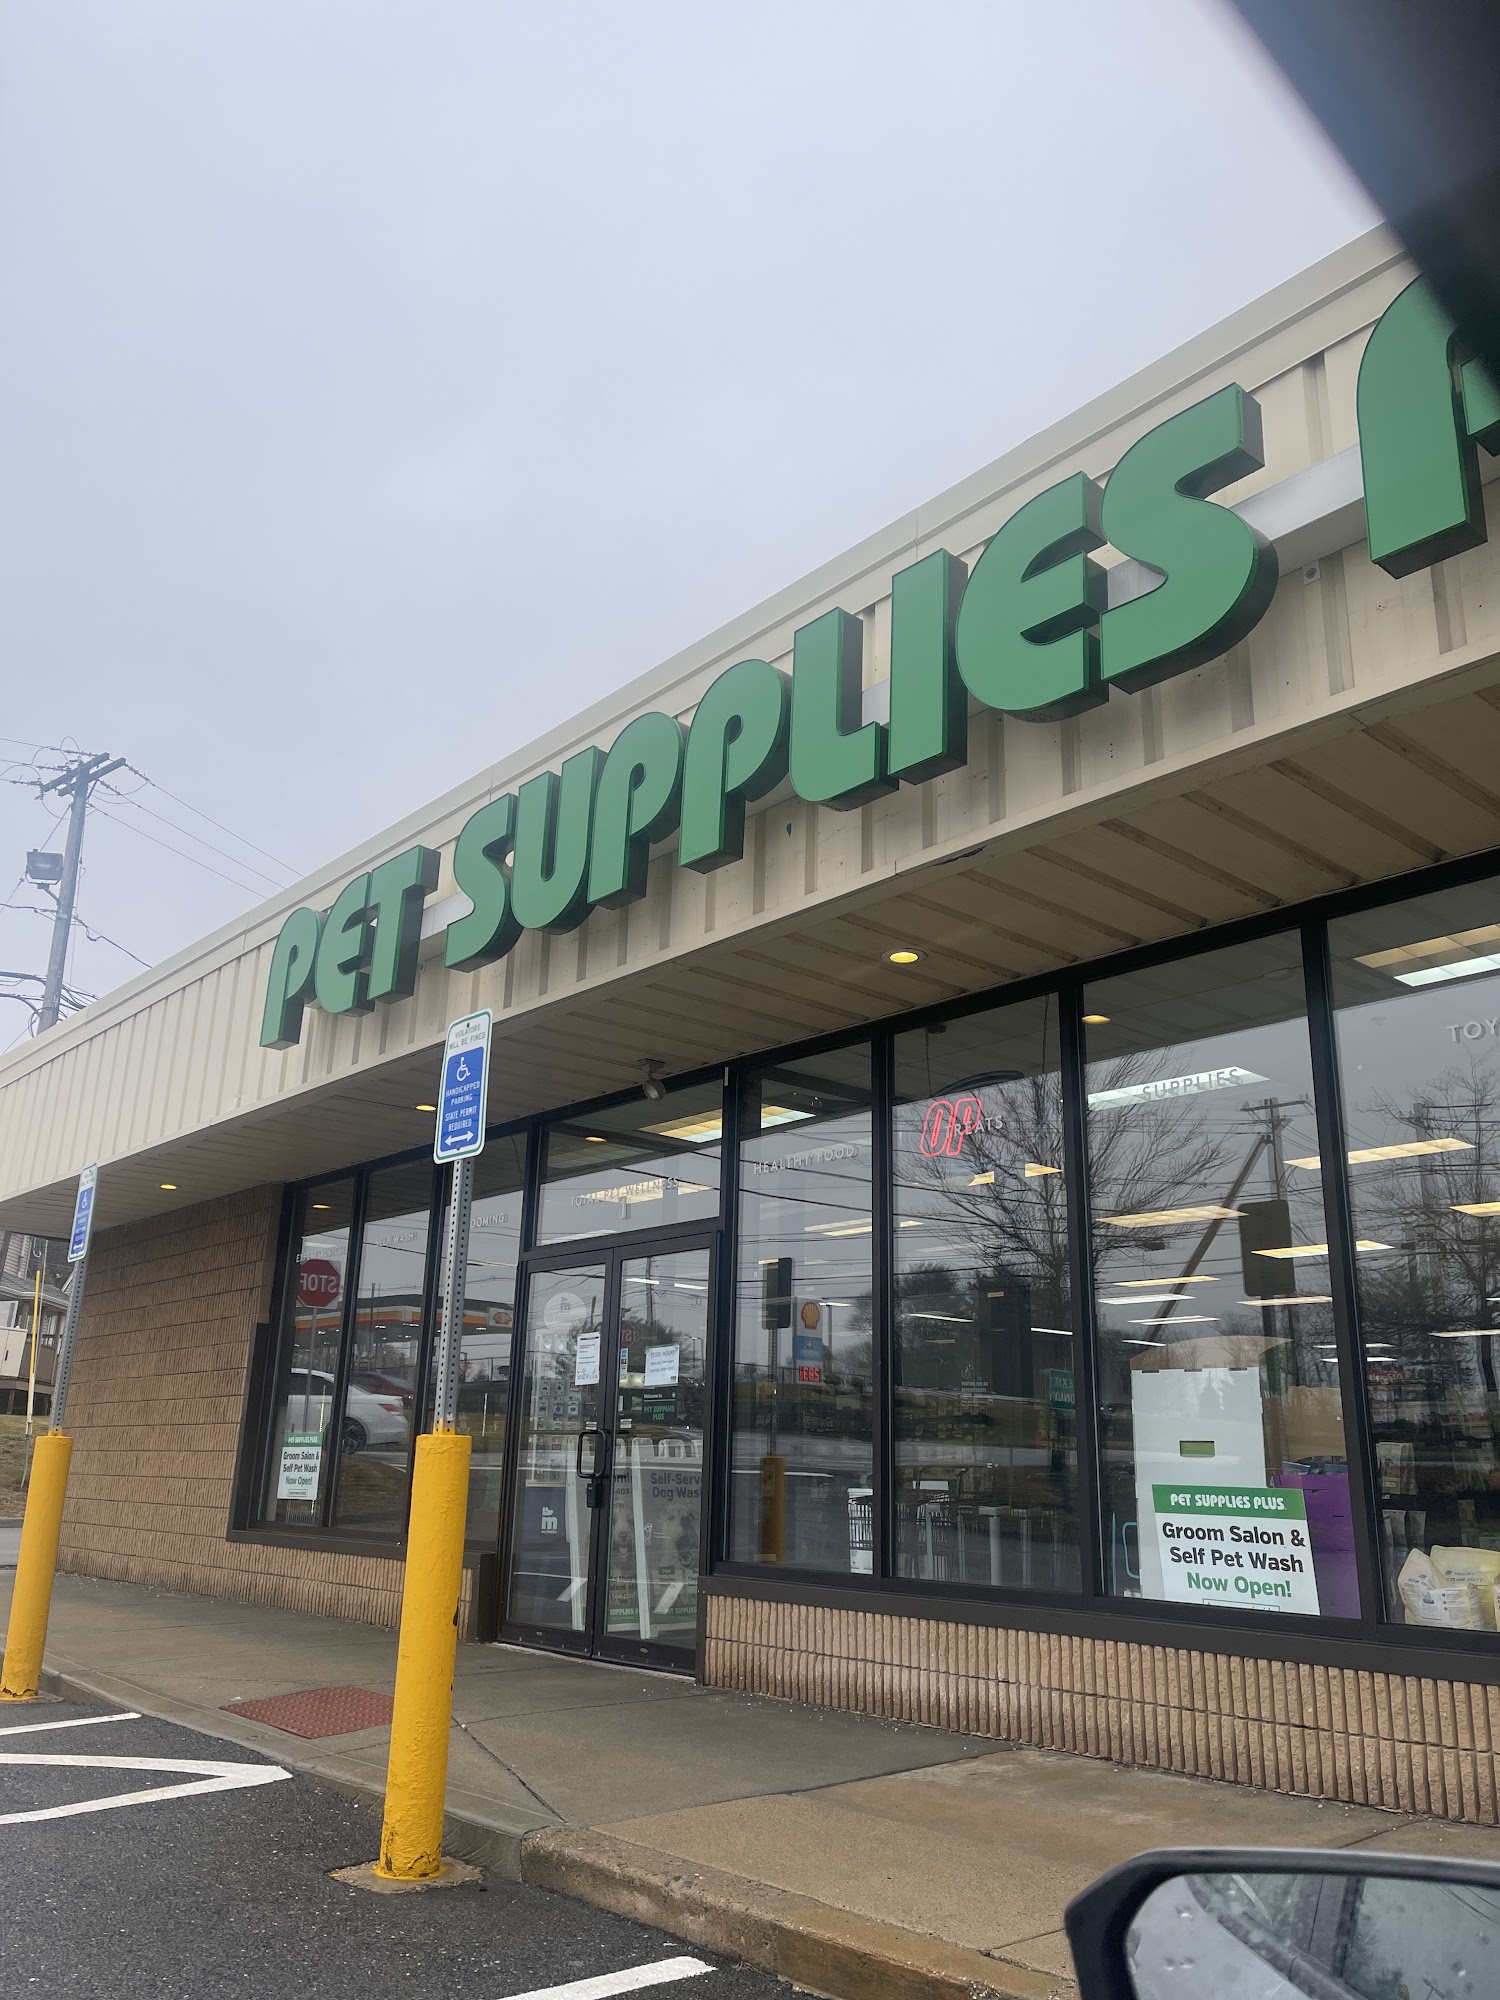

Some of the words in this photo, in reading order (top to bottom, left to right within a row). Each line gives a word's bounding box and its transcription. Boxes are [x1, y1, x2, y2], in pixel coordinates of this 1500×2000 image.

[260, 845, 441, 1050] PET
[445, 383, 1278, 972] SUPPLIES
[455, 1024, 481, 1039] VIOLATORS
[1447, 1017, 1499, 1042] TOY
[450, 1041, 460, 1050] WILL
[461, 1038, 467, 1046] BE
[470, 1032, 485, 1043] FINED
[445, 1081, 480, 1097] HANDICAPPED
[1142, 1068, 1242, 1101] SUPPLIES
[451, 1094, 473, 1105] PARKING
[445, 1110, 458, 1121] STATE
[460, 1106, 477, 1117] PERMIT
[448, 1118, 472, 1132] REQUIRED
[944, 1115, 1004, 1137] TREATS
[753, 1153, 812, 1175] HEALTHY
[817, 1143, 858, 1163] FOOD
[571, 1192, 599, 1208] TOTAL
[604, 1187, 620, 1200] PET
[625, 1177, 681, 1195] WELLNESS
[393, 1232, 415, 1244] WASH
[652, 1412, 665, 1421] PLUS
[653, 1404, 675, 1413] SUPPLIES
[283, 1451, 300, 1460] Groom
[301, 1451, 315, 1460] Salon
[283, 1464, 294, 1473] Self
[294, 1464, 303, 1473] Pet
[304, 1464, 318, 1473] Wash
[285, 1476, 297, 1485] Now
[298, 1476, 313, 1488] Open!
[650, 1471, 702, 1486] Self-Serv
[652, 1486, 675, 1501] Dog
[676, 1485, 701, 1499] Was
[1170, 1493, 1192, 1506] PET
[1195, 1494, 1251, 1509] SUPPLIES
[1162, 1522, 1225, 1543] Groom
[1229, 1525, 1285, 1546] Salon
[1290, 1529, 1306, 1547] &
[1170, 1547, 1206, 1565] Self
[1211, 1549, 1244, 1568] Pet
[1248, 1551, 1304, 1573] Wash
[1187, 1572, 1228, 1592] Now
[1234, 1575, 1292, 1599] Open!
